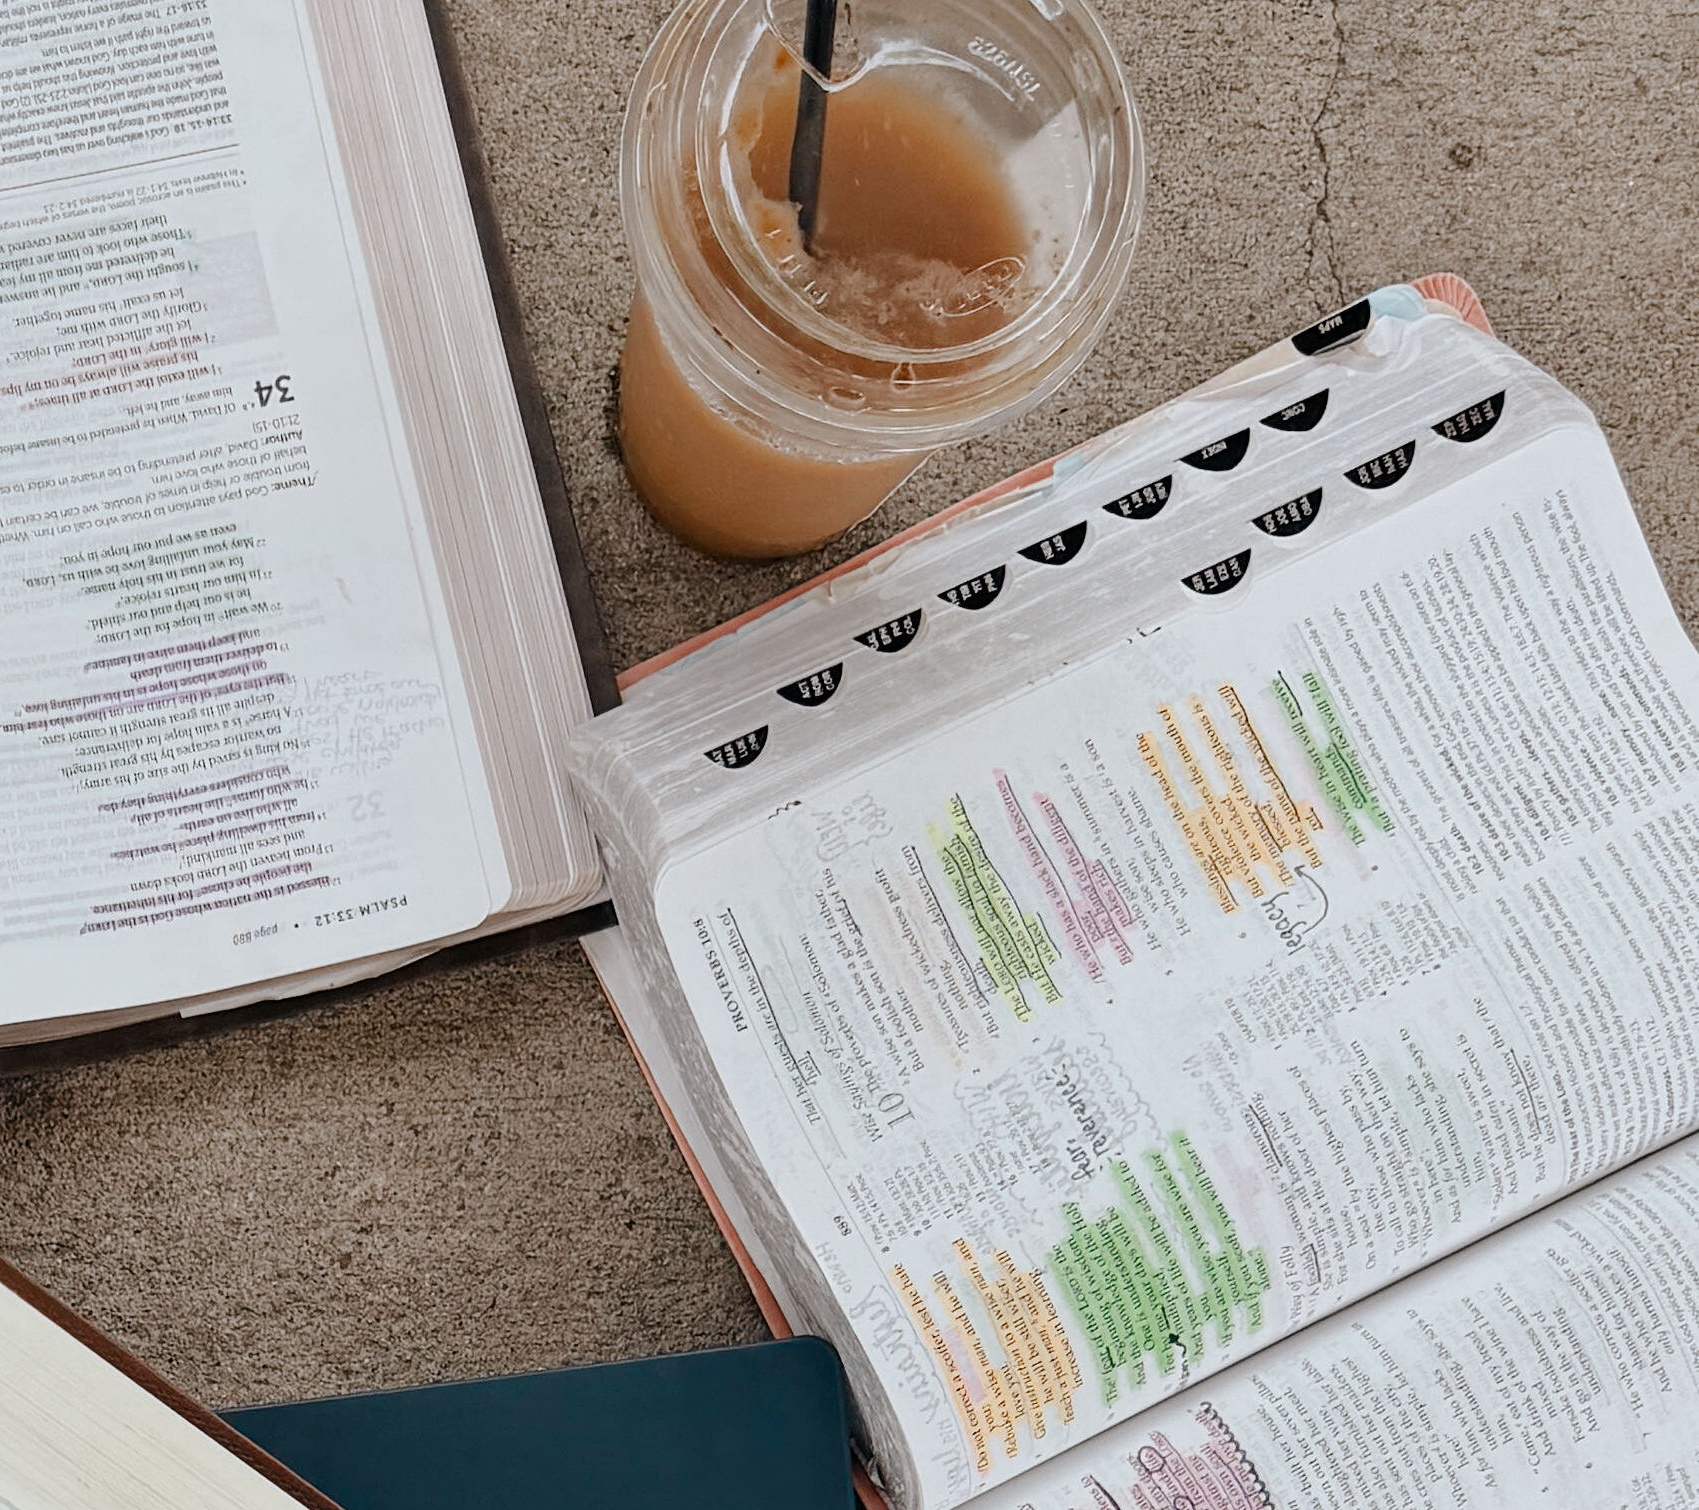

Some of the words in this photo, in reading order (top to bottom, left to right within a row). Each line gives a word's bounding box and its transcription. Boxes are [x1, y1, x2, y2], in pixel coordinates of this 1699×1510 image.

[253, 374, 295, 407] 34
[314, 907, 356, 927] 33:12
[358, 894, 408, 916] PSALM
[692, 917, 712, 946] 10:8
[704, 949, 748, 1032] PROVERBS
